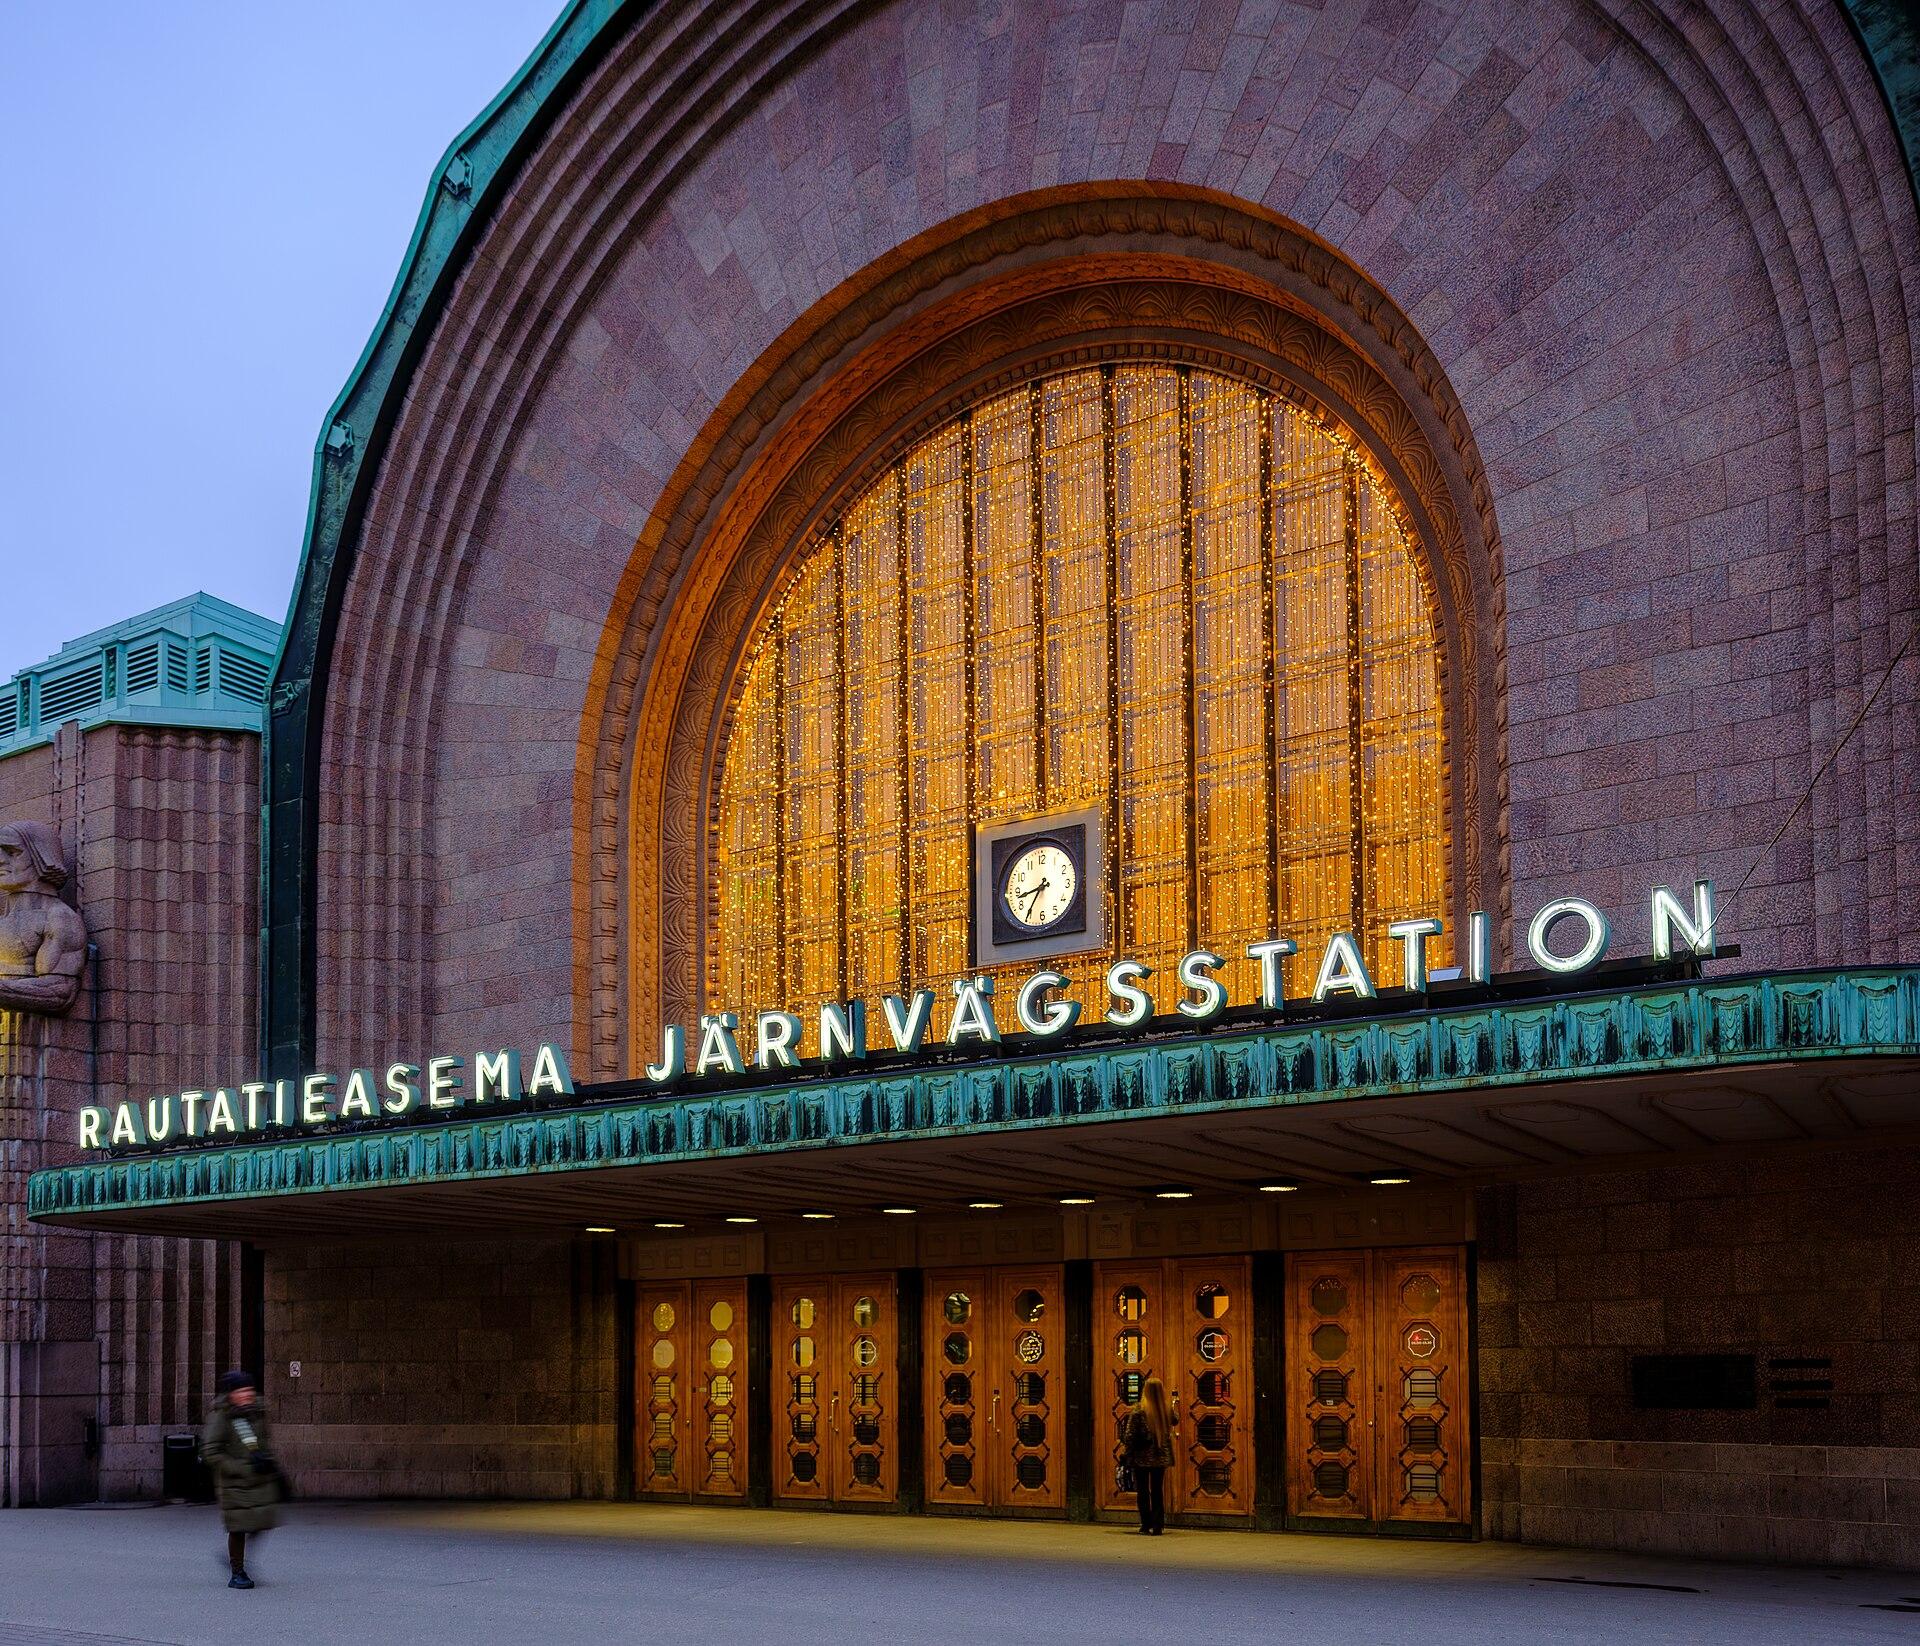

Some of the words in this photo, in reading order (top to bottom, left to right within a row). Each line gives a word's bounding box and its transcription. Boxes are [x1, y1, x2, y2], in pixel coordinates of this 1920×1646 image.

[1038, 854, 1046, 865] 12
[1027, 860, 1033, 871] 11
[1061, 864, 1067, 875] 2
[1017, 872, 1025, 883] 10
[1065, 878, 1071, 889] 3
[1015, 886, 1021, 898] 9
[1018, 900, 1024, 910] 8
[1052, 905, 1058, 916] 5
[1039, 910, 1046, 921] 6
[645, 878, 1716, 1083] JÄRNVÄGSSTATION
[79, 1042, 575, 1150] RAUTATIEASEMA
